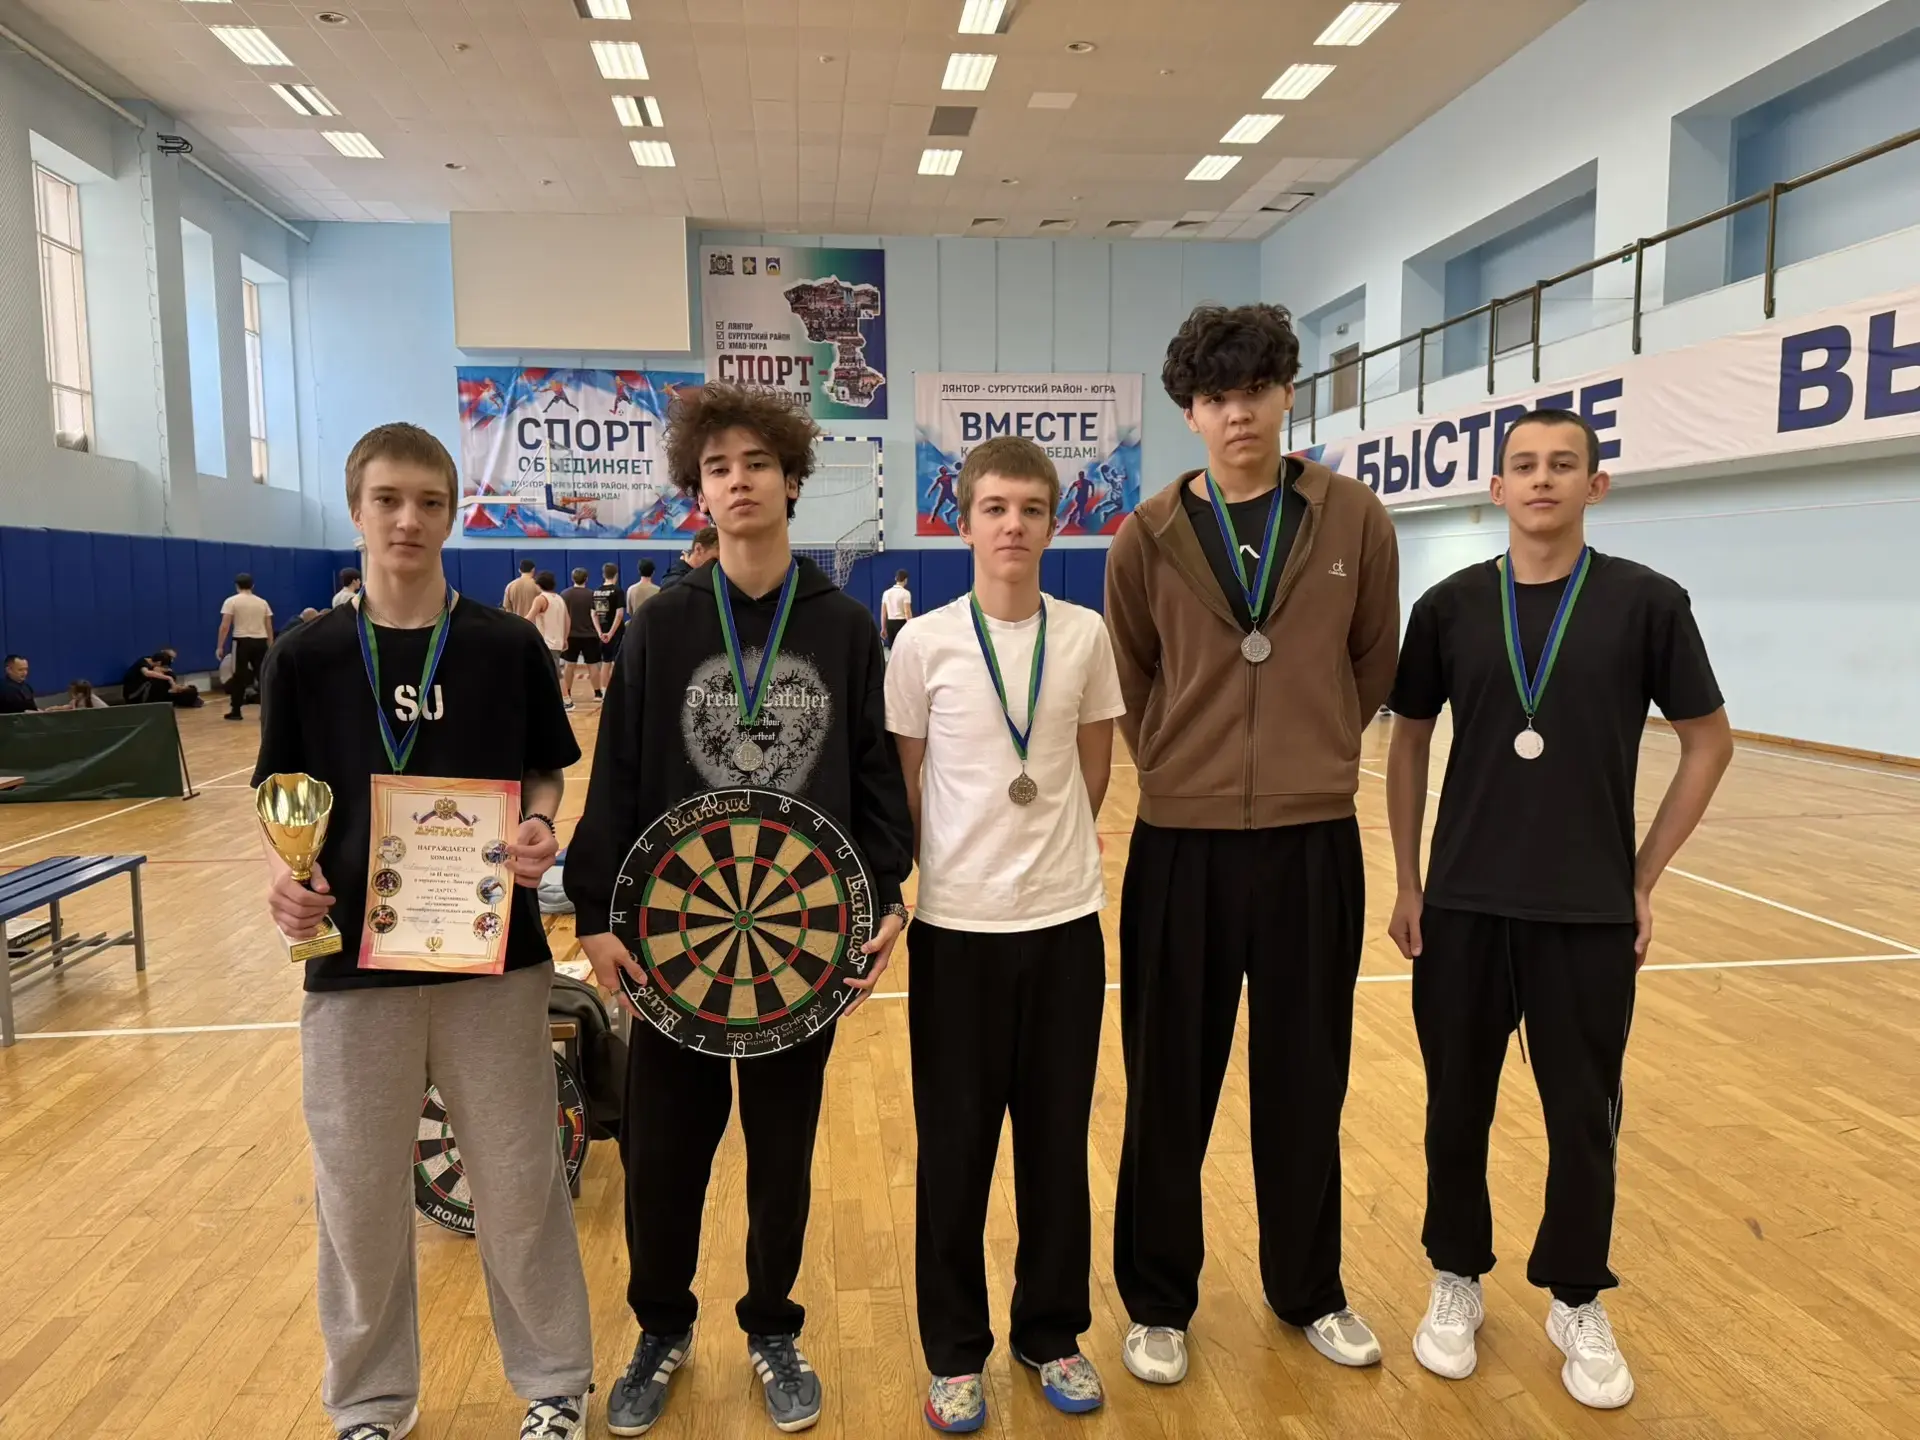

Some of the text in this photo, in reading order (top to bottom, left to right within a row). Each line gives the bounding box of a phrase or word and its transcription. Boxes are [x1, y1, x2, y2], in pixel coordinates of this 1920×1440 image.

[728, 322, 753, 330] ЛЯНТОР
[728, 331, 790, 341] СУРГУТСКИЙ РАЙОН
[728, 341, 768, 350] ХМАО-ЮГРА
[718, 354, 814, 386] СПОРТ
[941, 383, 980, 394] ЛЯНТОР
[987, 382, 1048, 394] СУРГУТСКИЙ
[1051, 383, 1083, 394] РАЙОН
[1091, 385, 1116, 394] ЮГРА
[960, 411, 1099, 442] ВМЕСТЕ
[517, 417, 653, 453] СПОРТ
[631, 482, 653, 491] ЮГРА
[686, 685, 739, 708] Drea
[740, 731, 776, 741] Hartbeat
[779, 795, 793, 813] 18
[812, 816, 825, 831] 4
[418, 844, 476, 853] НАГРАЖДАЕТСЯ
[835, 841, 853, 859] 13
[609, 911, 627, 925] 14
[726, 1032, 753, 1041] PRO
[755, 1000, 822, 1038] MATCHPLAY
[728, 1040, 746, 1057] 19
[432, 1204, 476, 1229] ROUN
